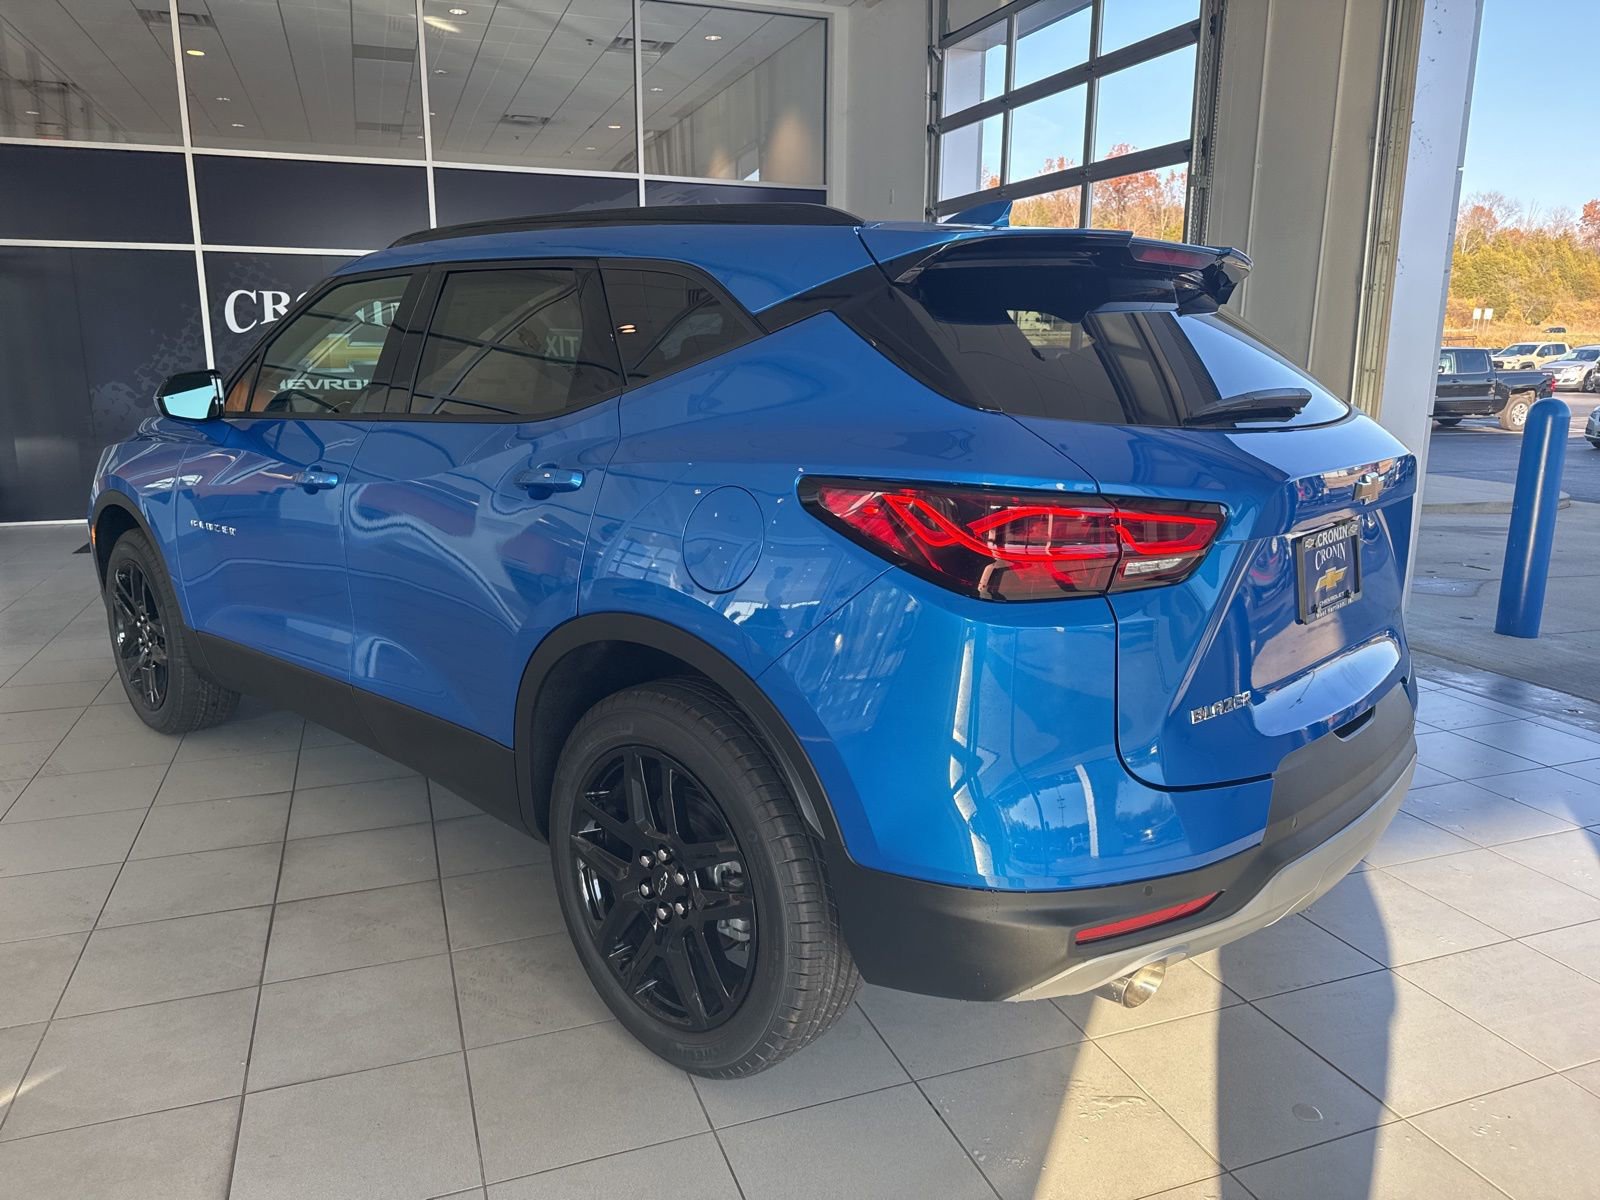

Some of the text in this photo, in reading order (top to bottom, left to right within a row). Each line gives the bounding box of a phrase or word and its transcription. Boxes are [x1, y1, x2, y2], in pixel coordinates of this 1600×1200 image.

[544, 335, 579, 357] XIT
[1317, 525, 1348, 547] CRONIN
[1315, 542, 1346, 570] CRONIN
[1190, 690, 1252, 725] BLAZER
